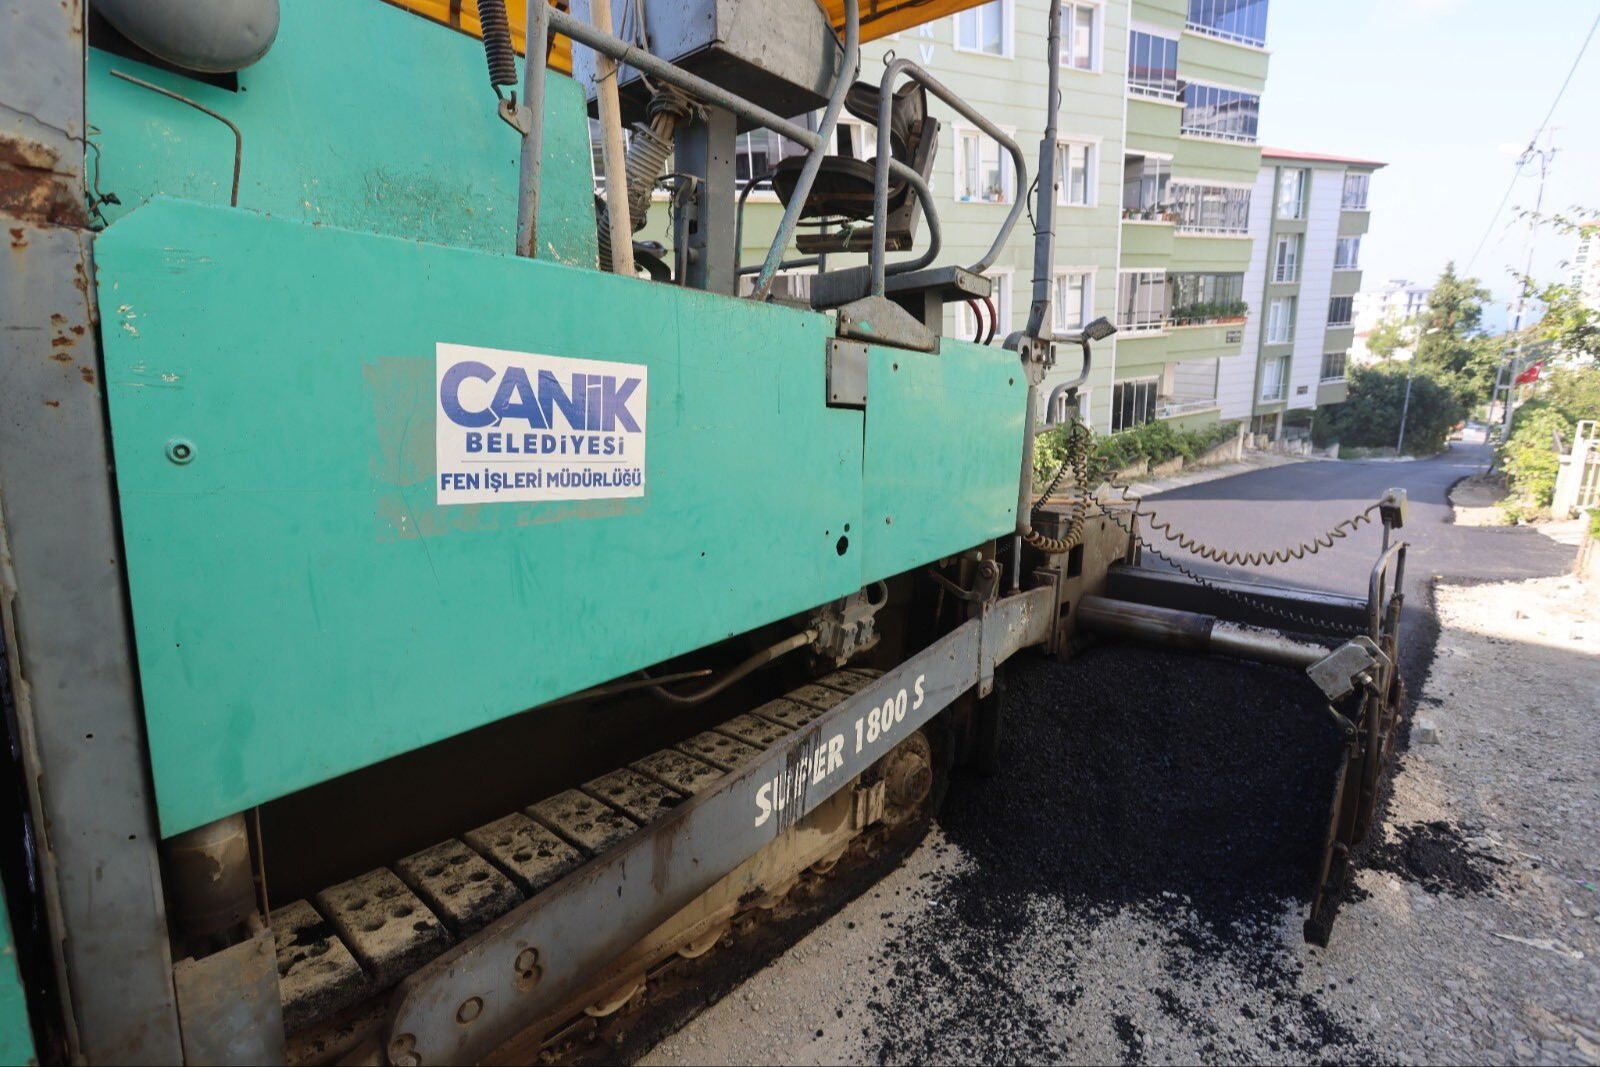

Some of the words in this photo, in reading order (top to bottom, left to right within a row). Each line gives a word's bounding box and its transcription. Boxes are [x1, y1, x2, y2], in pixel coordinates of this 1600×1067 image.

[440, 472, 480, 491] FEN
[484, 468, 542, 493] İŞLERİ
[546, 468, 642, 488] MÜDÜRLÜĞÜ
[854, 688, 908, 755] 1800
[912, 673, 925, 711] S
